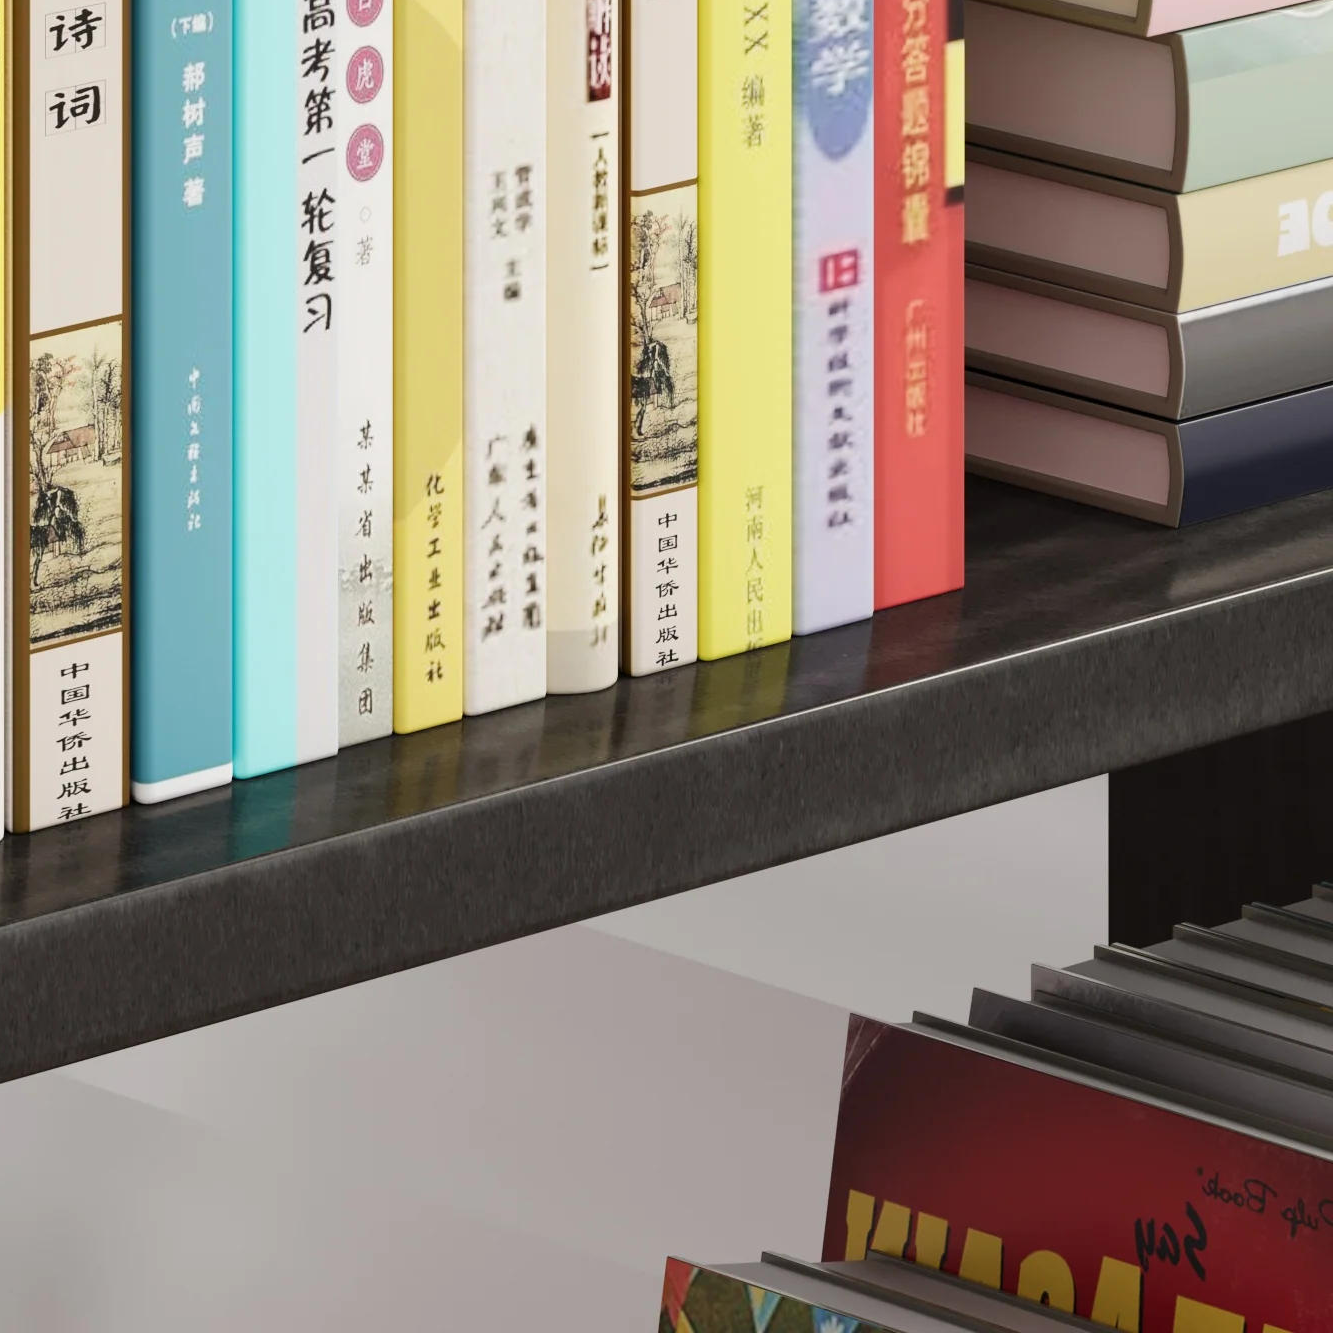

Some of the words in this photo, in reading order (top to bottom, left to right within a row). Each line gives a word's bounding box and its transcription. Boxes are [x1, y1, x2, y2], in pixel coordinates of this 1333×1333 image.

[655, 512, 680, 667] 中国华侨出版社
[56, 662, 93, 820] 中国华侨出版社
